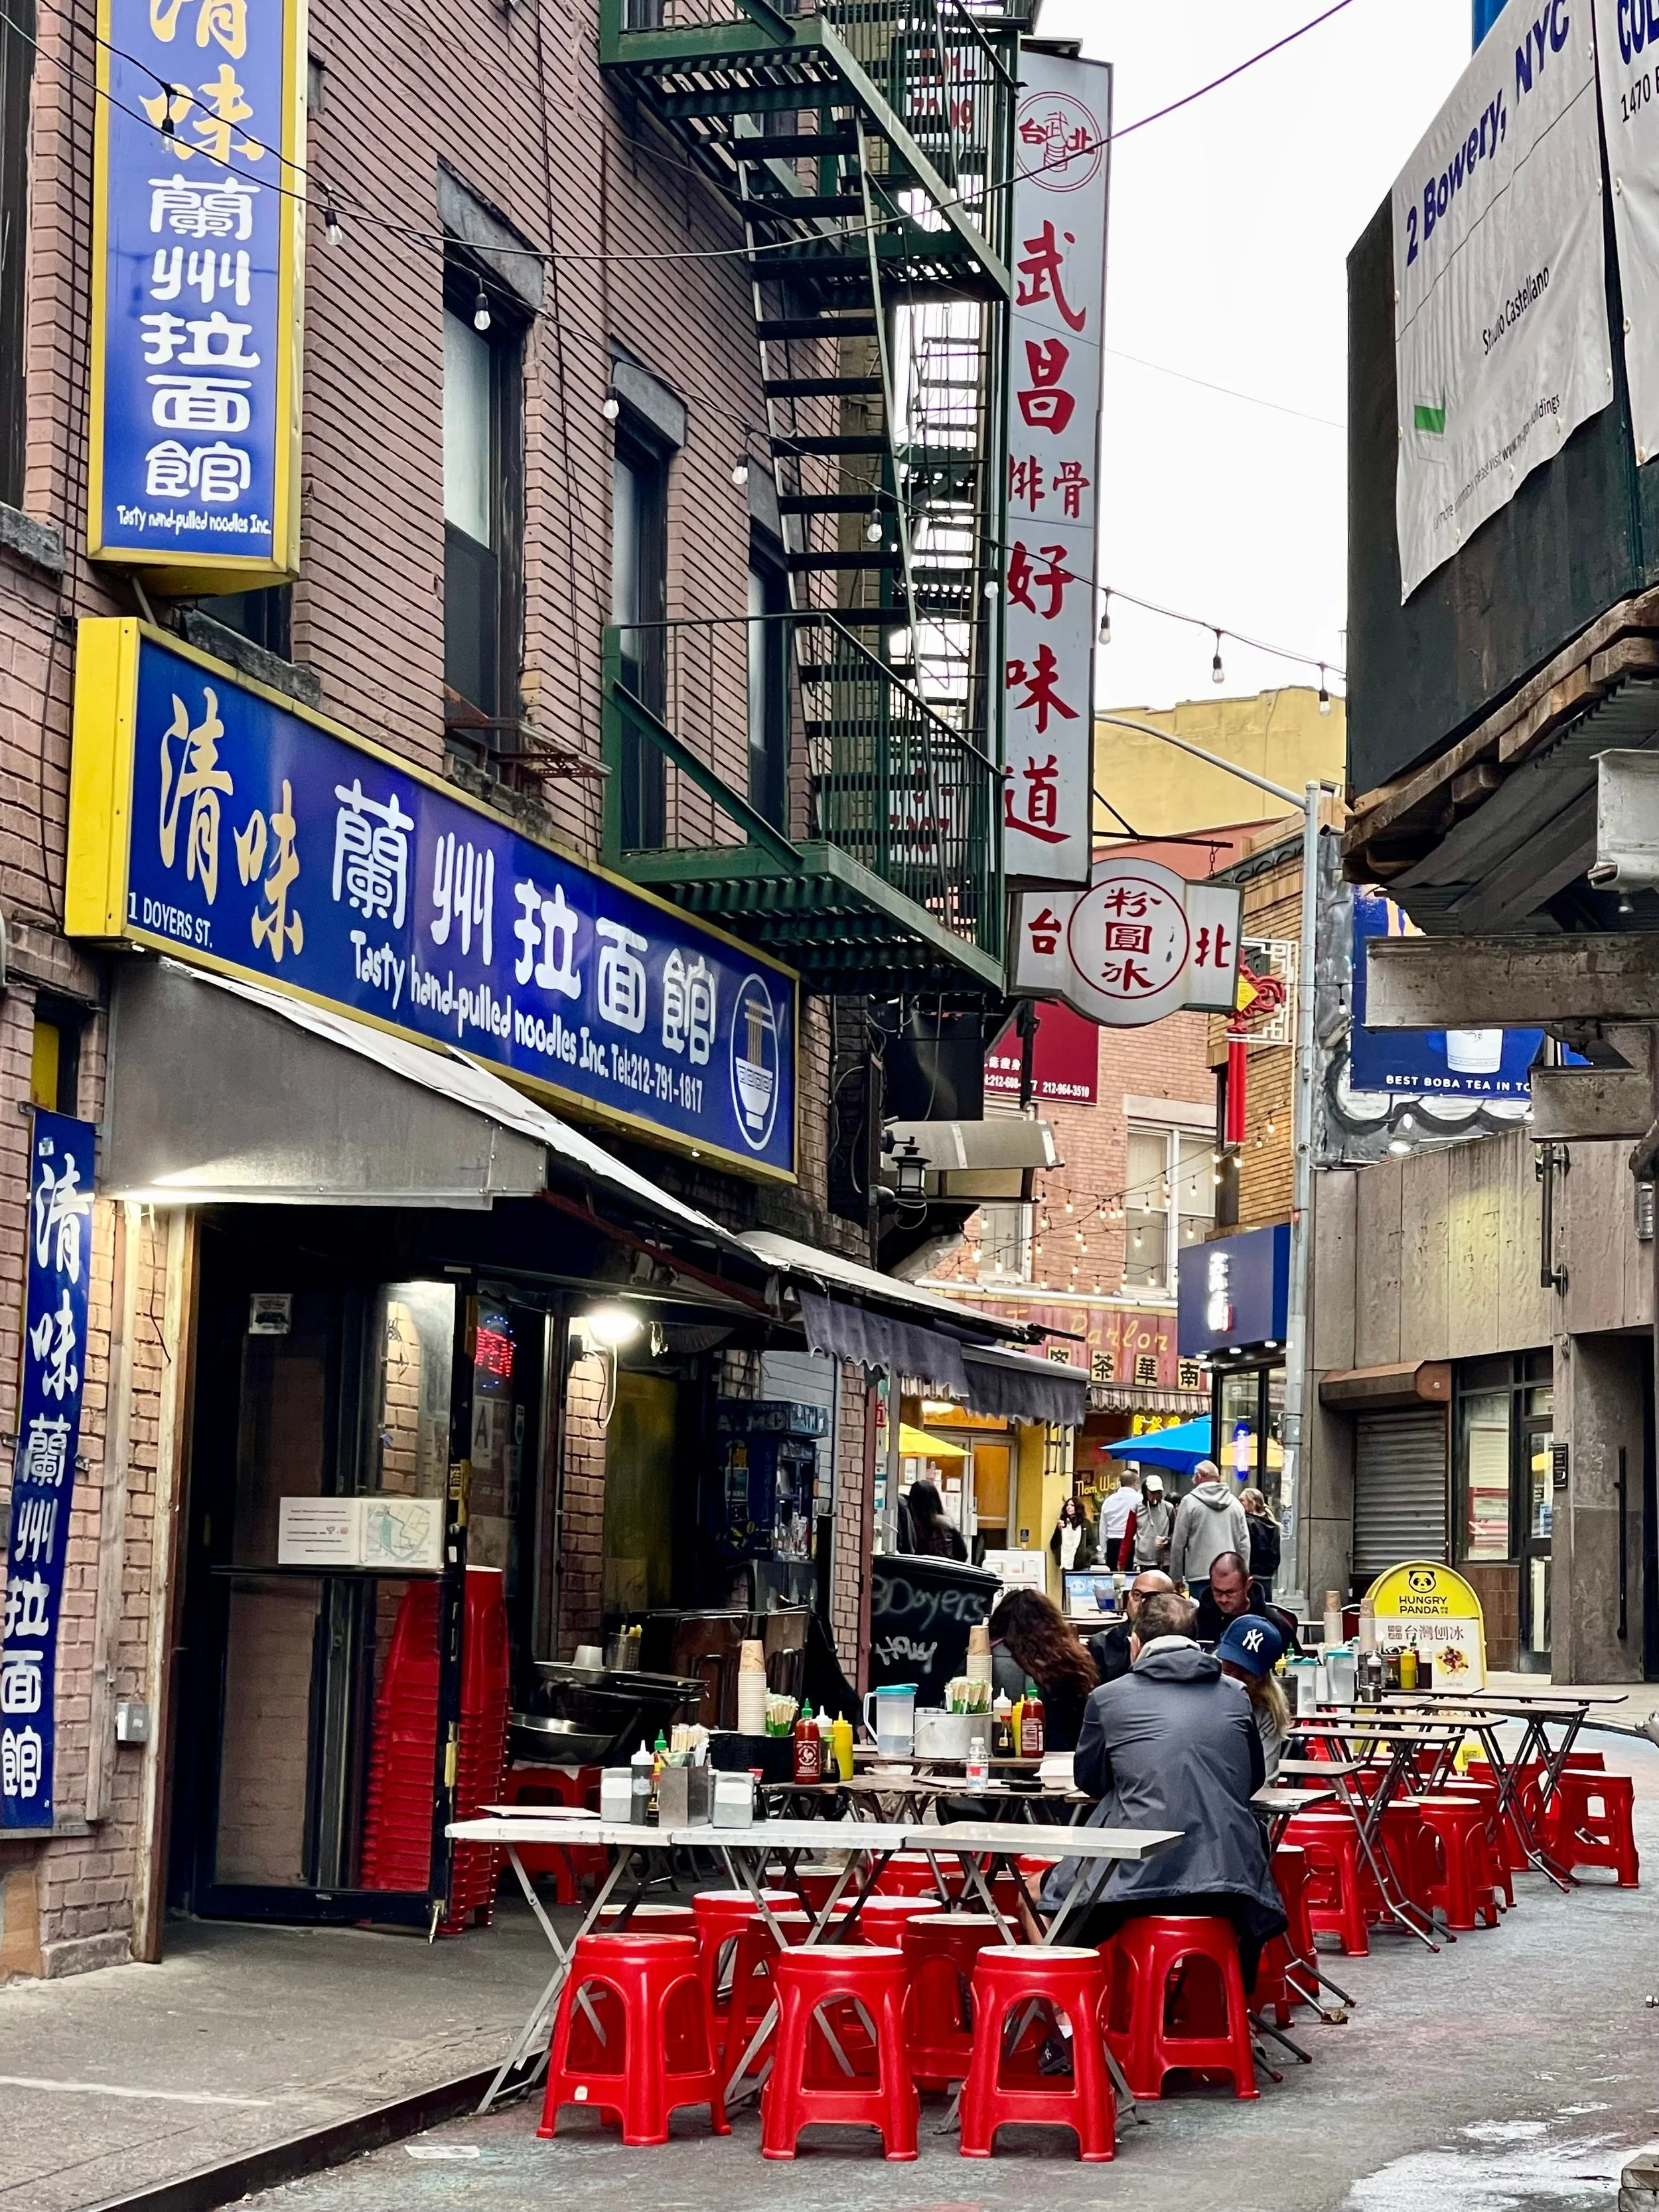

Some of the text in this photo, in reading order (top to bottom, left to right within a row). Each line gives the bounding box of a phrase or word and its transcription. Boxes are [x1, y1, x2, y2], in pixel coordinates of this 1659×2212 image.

[1621, 74, 1651, 123] 1470
[1406, 0, 1569, 267] 2 Bowery, NYC
[1506, 267, 1549, 327] Castellano
[116, 505, 147, 531] Tasty
[210, 513, 248, 534] noodles
[128, 892, 213, 948] 1 DOYERS ST.
[1028, 908, 1232, 968] 台 北
[350, 930, 703, 1114] Tasty hand-pulled noodles Inc. Tel:212-791-1817
[1386, 1074, 1419, 1086] BEST
[1424, 1076, 1461, 1088] BOBA
[1465, 1079, 1491, 1090] TEA
[1496, 1080, 1510, 1091] IN
[1070, 1313, 1168, 1352] Parlor
[1399, 1595, 1447, 1605] HUNGRY
[1400, 1605, 1439, 1614] PANDA
[1242, 1629, 1263, 1653] NY
